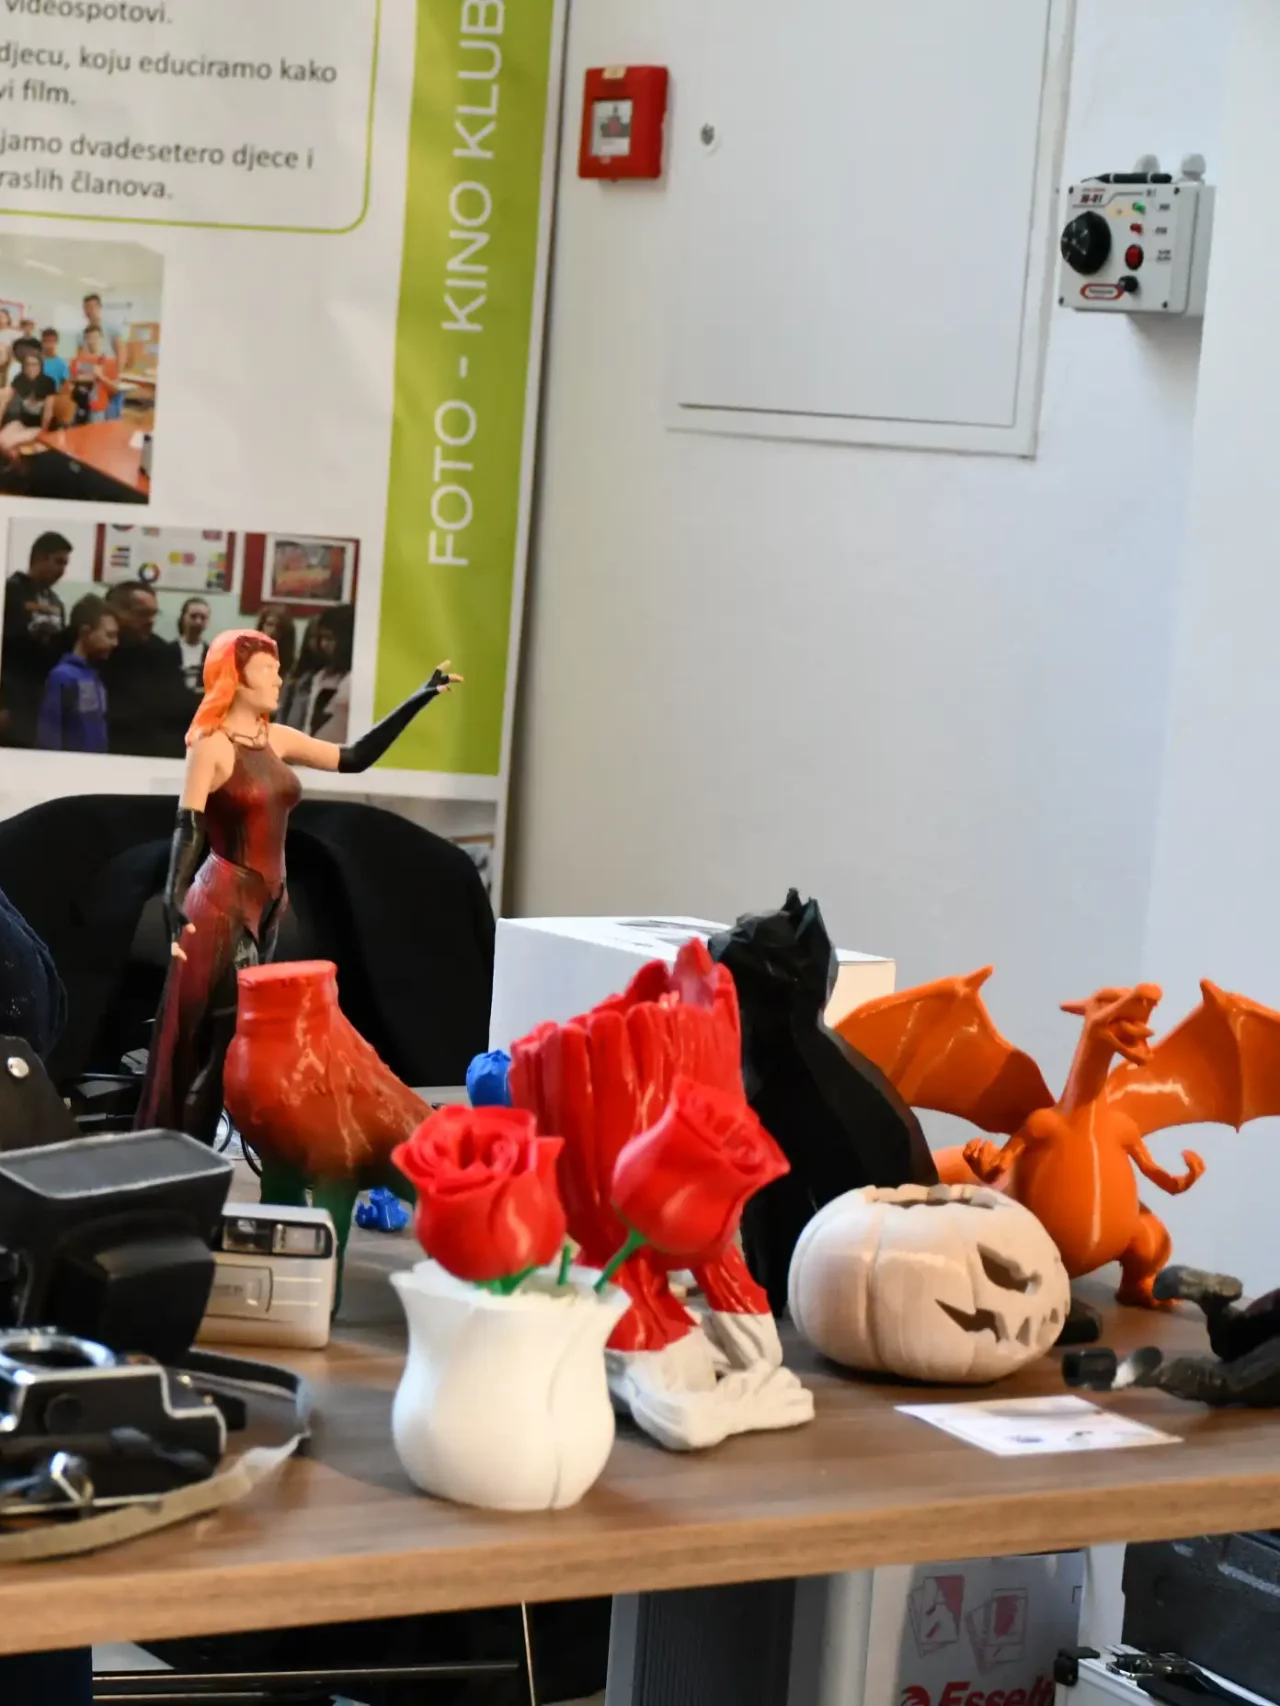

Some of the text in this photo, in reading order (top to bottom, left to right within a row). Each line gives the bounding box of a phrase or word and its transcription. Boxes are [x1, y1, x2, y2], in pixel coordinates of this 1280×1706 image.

[6, 0, 173, 24] videospotovi.
[79, 46, 131, 75] koju
[138, 51, 273, 80] educiramo
[279, 57, 338, 83] kako
[452, 0, 505, 159] KLUB
[22, 78, 76, 105] film.
[70, 134, 225, 166] dvadesetero
[231, 144, 299, 172] djece
[306, 147, 315, 170] i
[70, 170, 174, 199] članova.
[440, 181, 493, 332] KINO
[428, 399, 477, 566] FOTO
